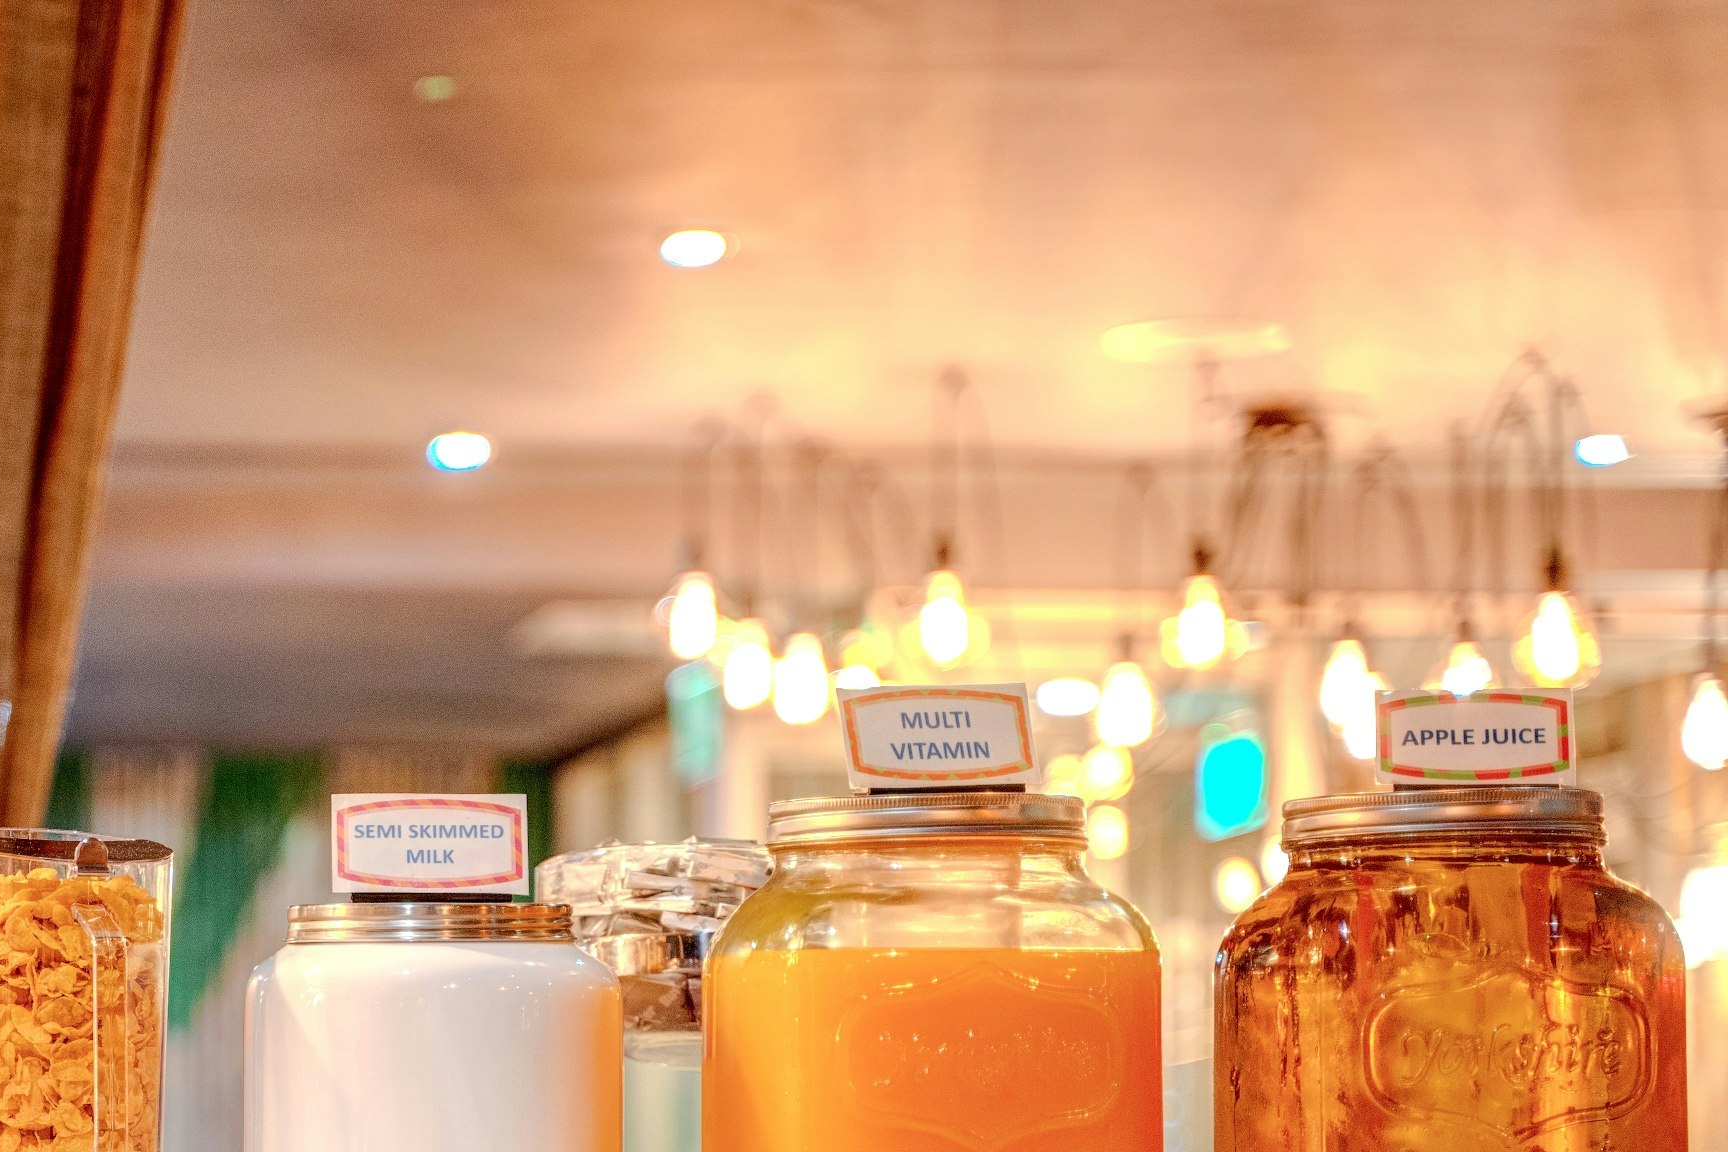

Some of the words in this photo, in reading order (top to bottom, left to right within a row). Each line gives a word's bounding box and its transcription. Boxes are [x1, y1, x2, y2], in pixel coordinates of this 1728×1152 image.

[900, 711, 972, 729] MULTI
[1401, 728, 1475, 746] APPLE
[1481, 727, 1546, 745] JUICE
[889, 741, 991, 760] VITAMIN
[353, 823, 402, 839] SEMI
[408, 823, 505, 839] SKIMMED
[406, 848, 455, 864] MILK
